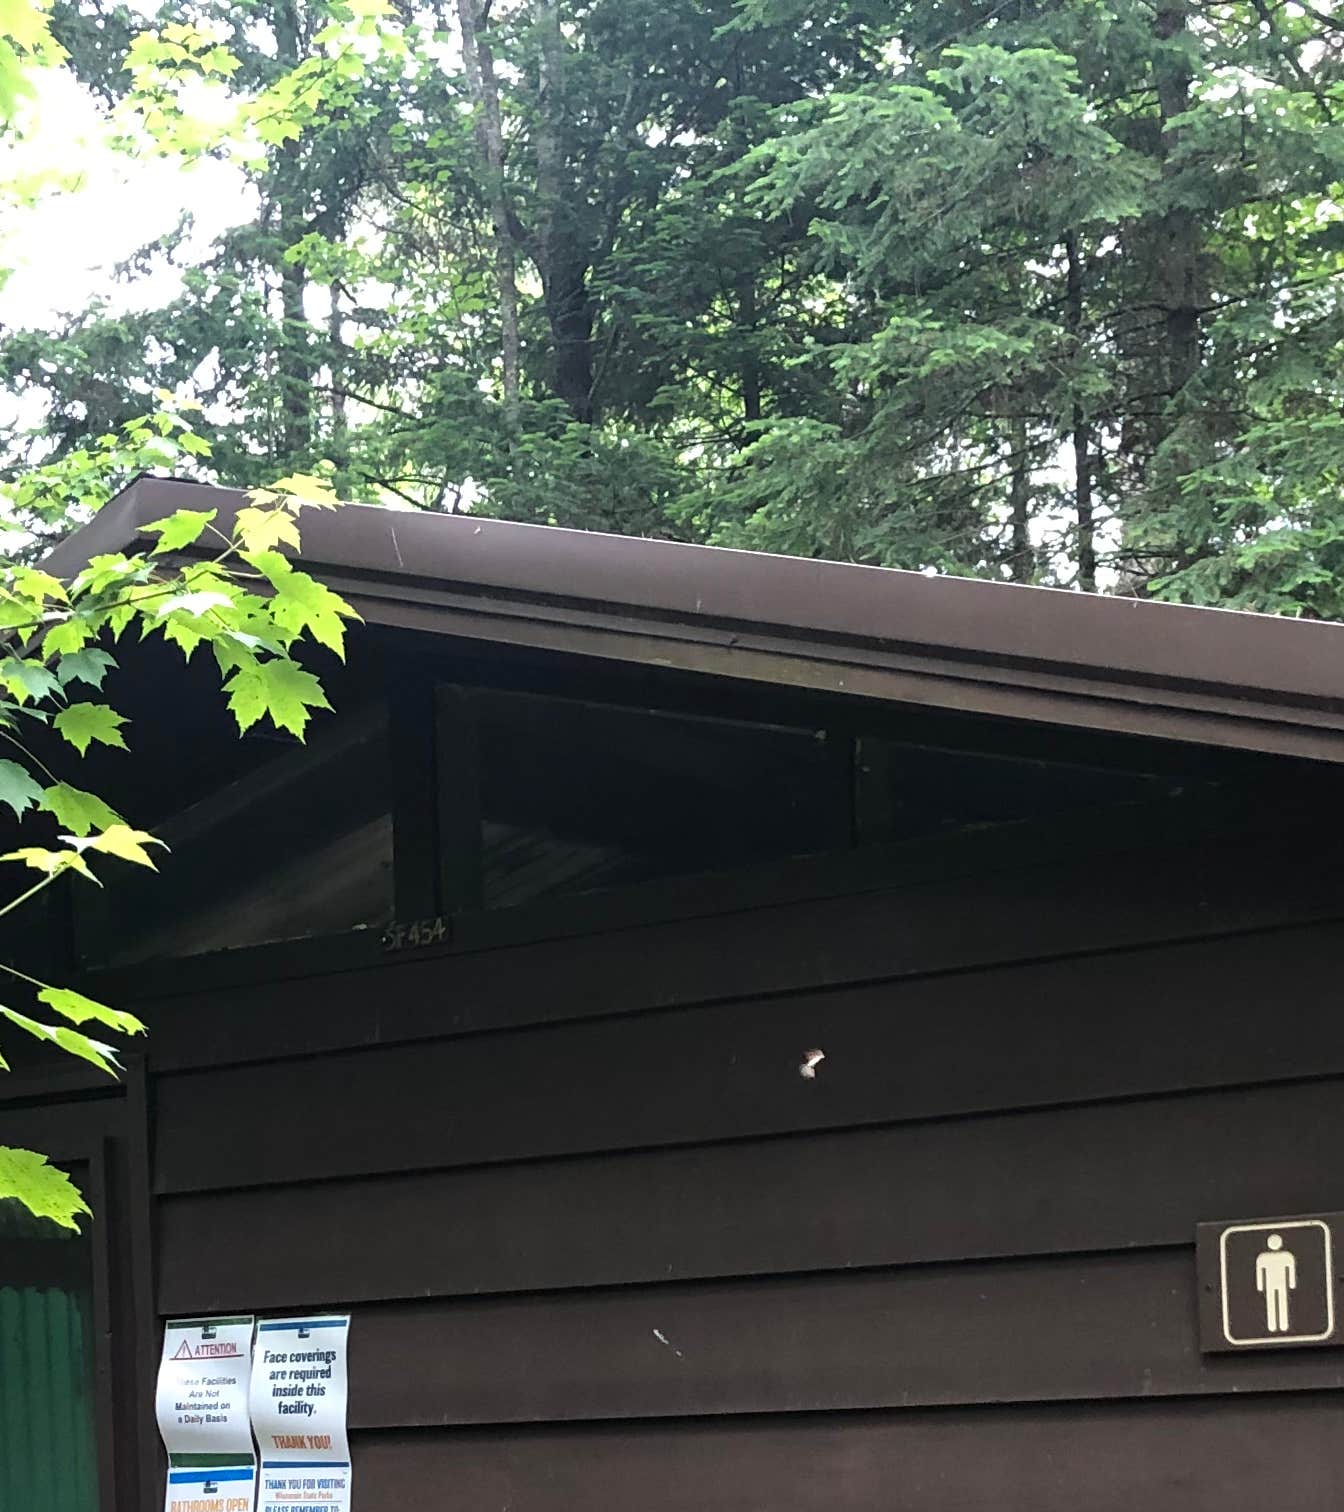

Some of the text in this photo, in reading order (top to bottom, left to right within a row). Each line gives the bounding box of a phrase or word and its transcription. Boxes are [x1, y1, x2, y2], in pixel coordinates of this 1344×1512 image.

[195, 1342, 237, 1356] ATTENTION
[263, 1348, 337, 1365] Face coverings
[269, 1365, 331, 1383] are required
[201, 1377, 237, 1386] Facilities
[189, 1390, 220, 1398] Are Not
[272, 1383, 326, 1397] inside this
[175, 1402, 231, 1411] Maintained on
[278, 1400, 317, 1417] facility.
[177, 1414, 228, 1425] a Daily Basis
[271, 1435, 332, 1450] THANK YOU!
[264, 1478, 346, 1490] THANK YOU FOR VISITING
[226, 1496, 249, 1512] OPEN
